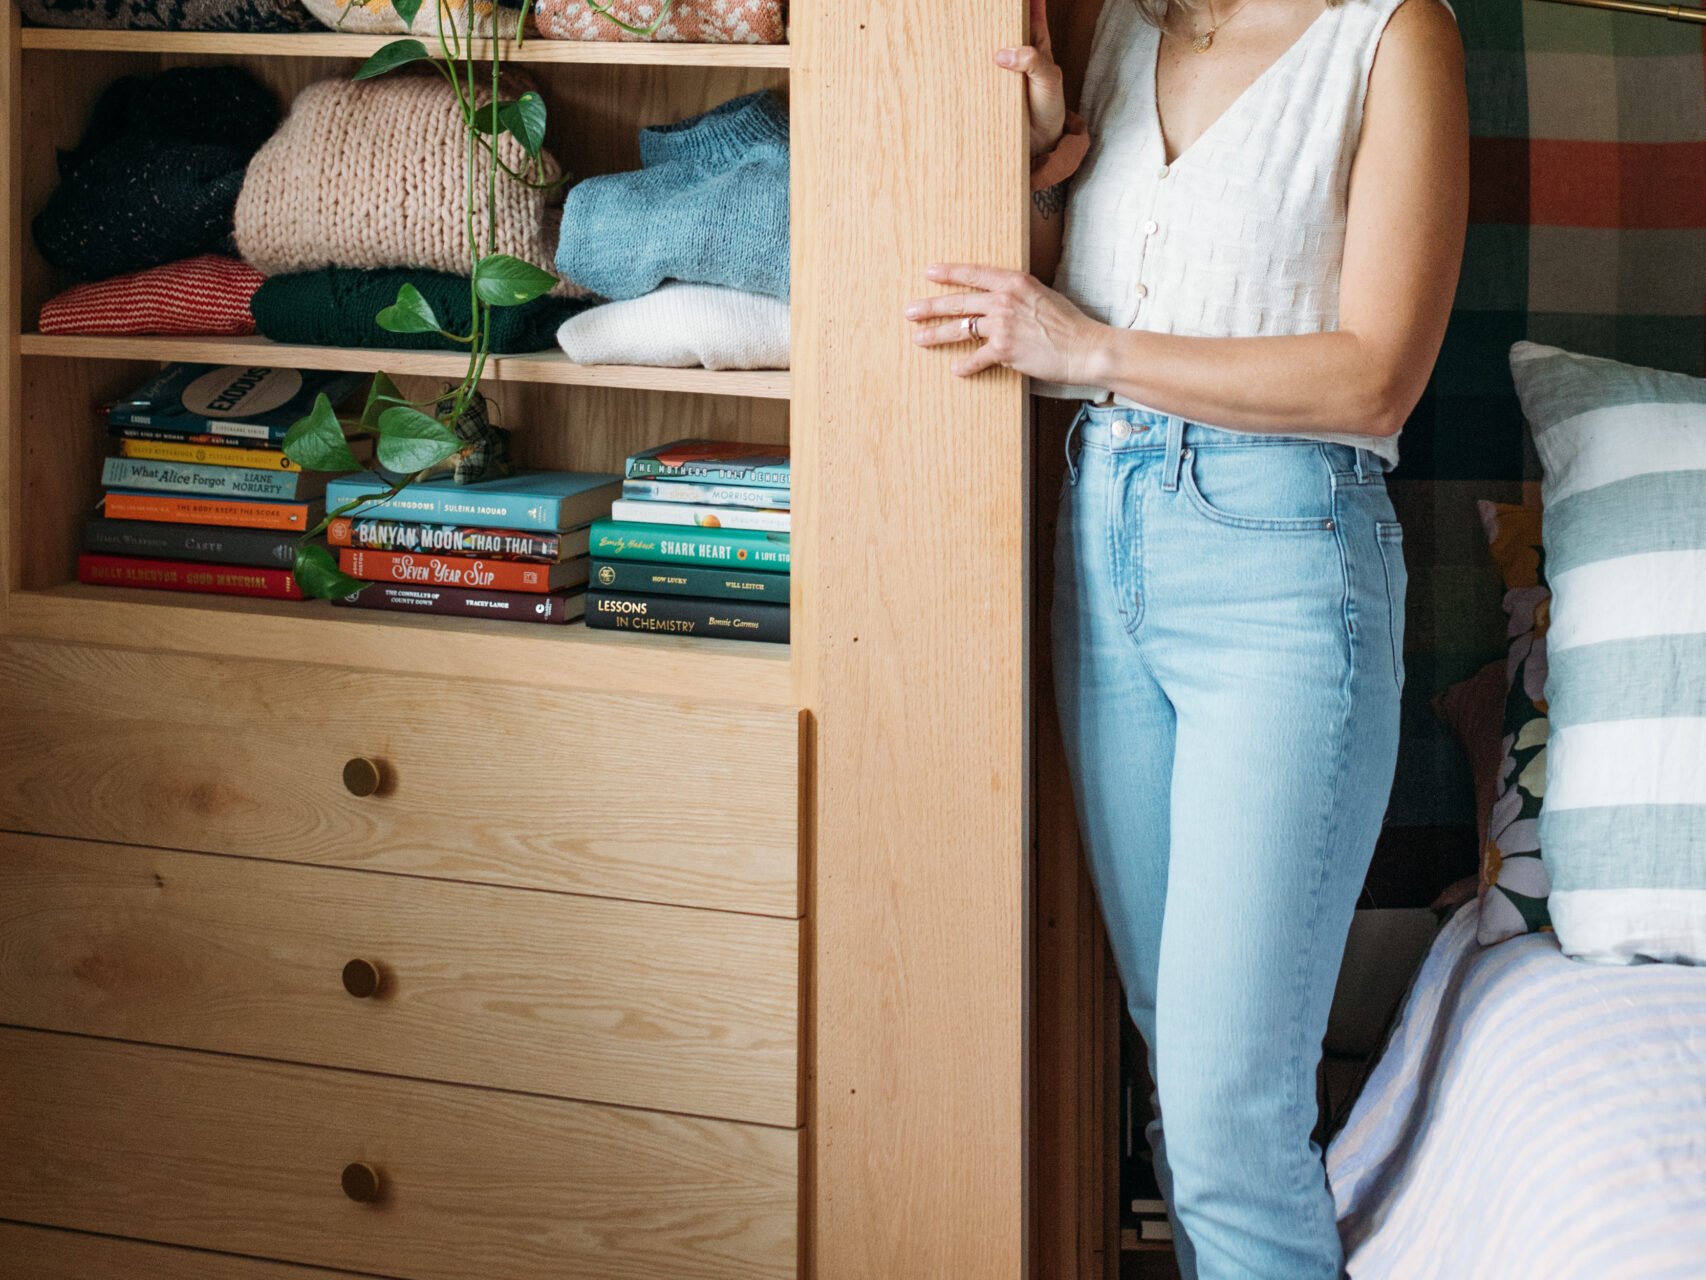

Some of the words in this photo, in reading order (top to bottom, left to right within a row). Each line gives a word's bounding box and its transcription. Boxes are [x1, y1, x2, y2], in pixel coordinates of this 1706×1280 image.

[207, 368, 272, 411] EXODUS
[131, 466, 158, 478] What
[158, 469, 190, 485] Alice
[192, 475, 226, 488] Forgot
[633, 463, 652, 473] THE
[658, 465, 708, 478] MOTHERS
[244, 473, 273, 483] LIANE
[232, 482, 282, 494] MORIARTY
[712, 491, 764, 502] MORRISON
[176, 504, 190, 512] THE
[214, 507, 238, 515] KEEPS
[240, 508, 254, 516] THE
[256, 510, 281, 518] SCORE
[393, 500, 434, 510] KINGDOMS
[444, 504, 476, 514] SULEIKA
[477, 506, 508, 516] JAOUAD
[359, 524, 417, 547] BANYAN
[421, 528, 465, 551] MOON
[470, 534, 502, 552] THAO
[505, 536, 533, 554] THAI
[660, 540, 695, 556] SHARK
[699, 544, 732, 560] HEART
[755, 552, 760, 560] A
[761, 552, 776, 561] LOVE
[392, 555, 430, 580] SEVEN
[430, 559, 461, 584] YEAR
[464, 560, 495, 586] SLIP
[216, 574, 269, 589] MATERIAL
[398, 590, 428, 599] CONNELLYS
[391, 597, 414, 605] COUNTY
[415, 598, 433, 606] DOWN
[465, 599, 488, 608] TRACEY
[598, 600, 648, 614] LESSONS
[616, 616, 628, 626] IN
[632, 617, 696, 632] CHEMISTRY
[708, 616, 732, 626] Bonnie
[733, 619, 760, 629] Garmus
